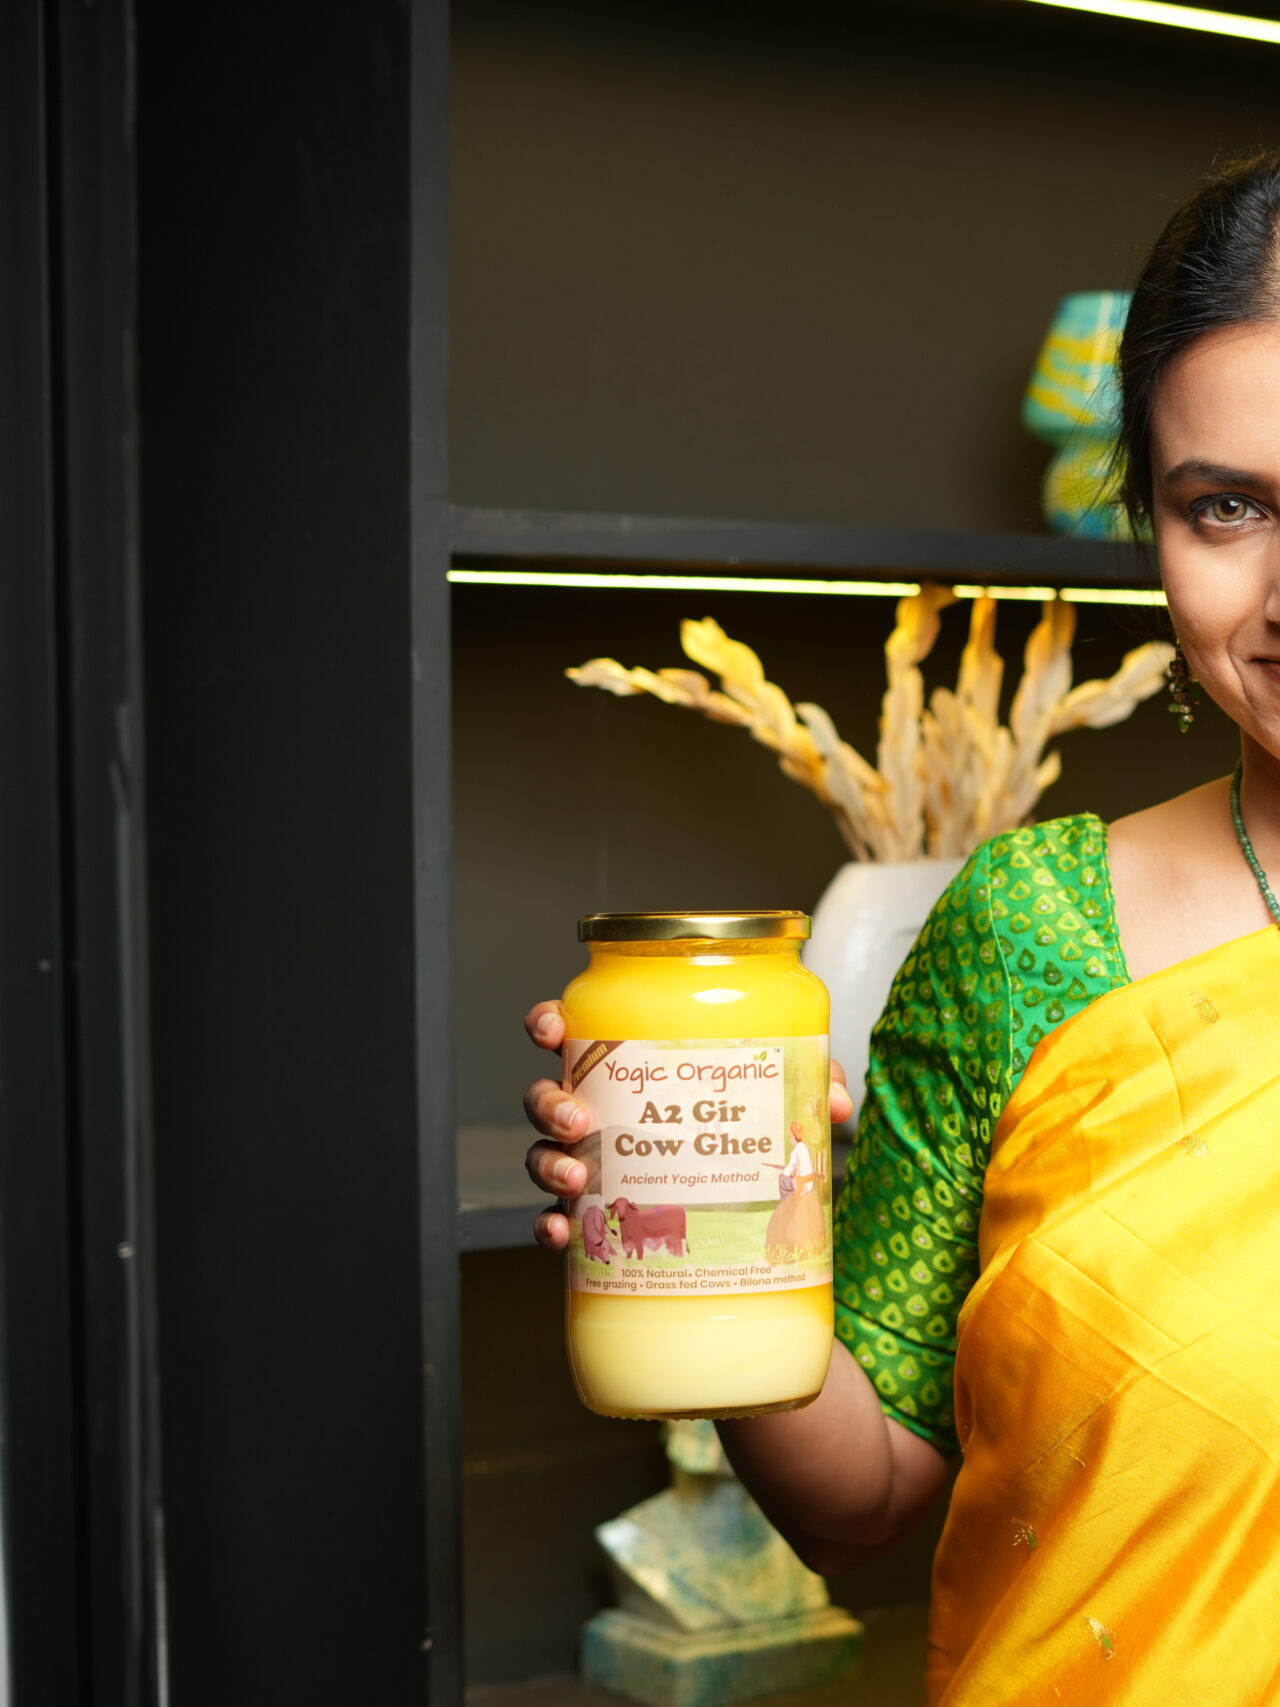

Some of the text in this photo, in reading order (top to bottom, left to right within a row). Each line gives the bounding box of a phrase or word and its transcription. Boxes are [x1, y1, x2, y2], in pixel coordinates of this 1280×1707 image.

[604, 1060, 668, 1093] Yogic
[676, 1061, 779, 1092] Organic
[638, 1100, 746, 1125] A2 Gir
[615, 1133, 772, 1157] Cow Ghee
[621, 1171, 760, 1187] Ancient Yogic Method
[603, 1279, 637, 1291] grazing
[646, 1280, 677, 1289] Grass
[679, 1280, 698, 1289] fed
[700, 1280, 731, 1288] Cows
[740, 1277, 771, 1287] Bilona
[773, 1273, 806, 1284] method
[621, 1266, 772, 1278] 100% Natural Chemical Free
